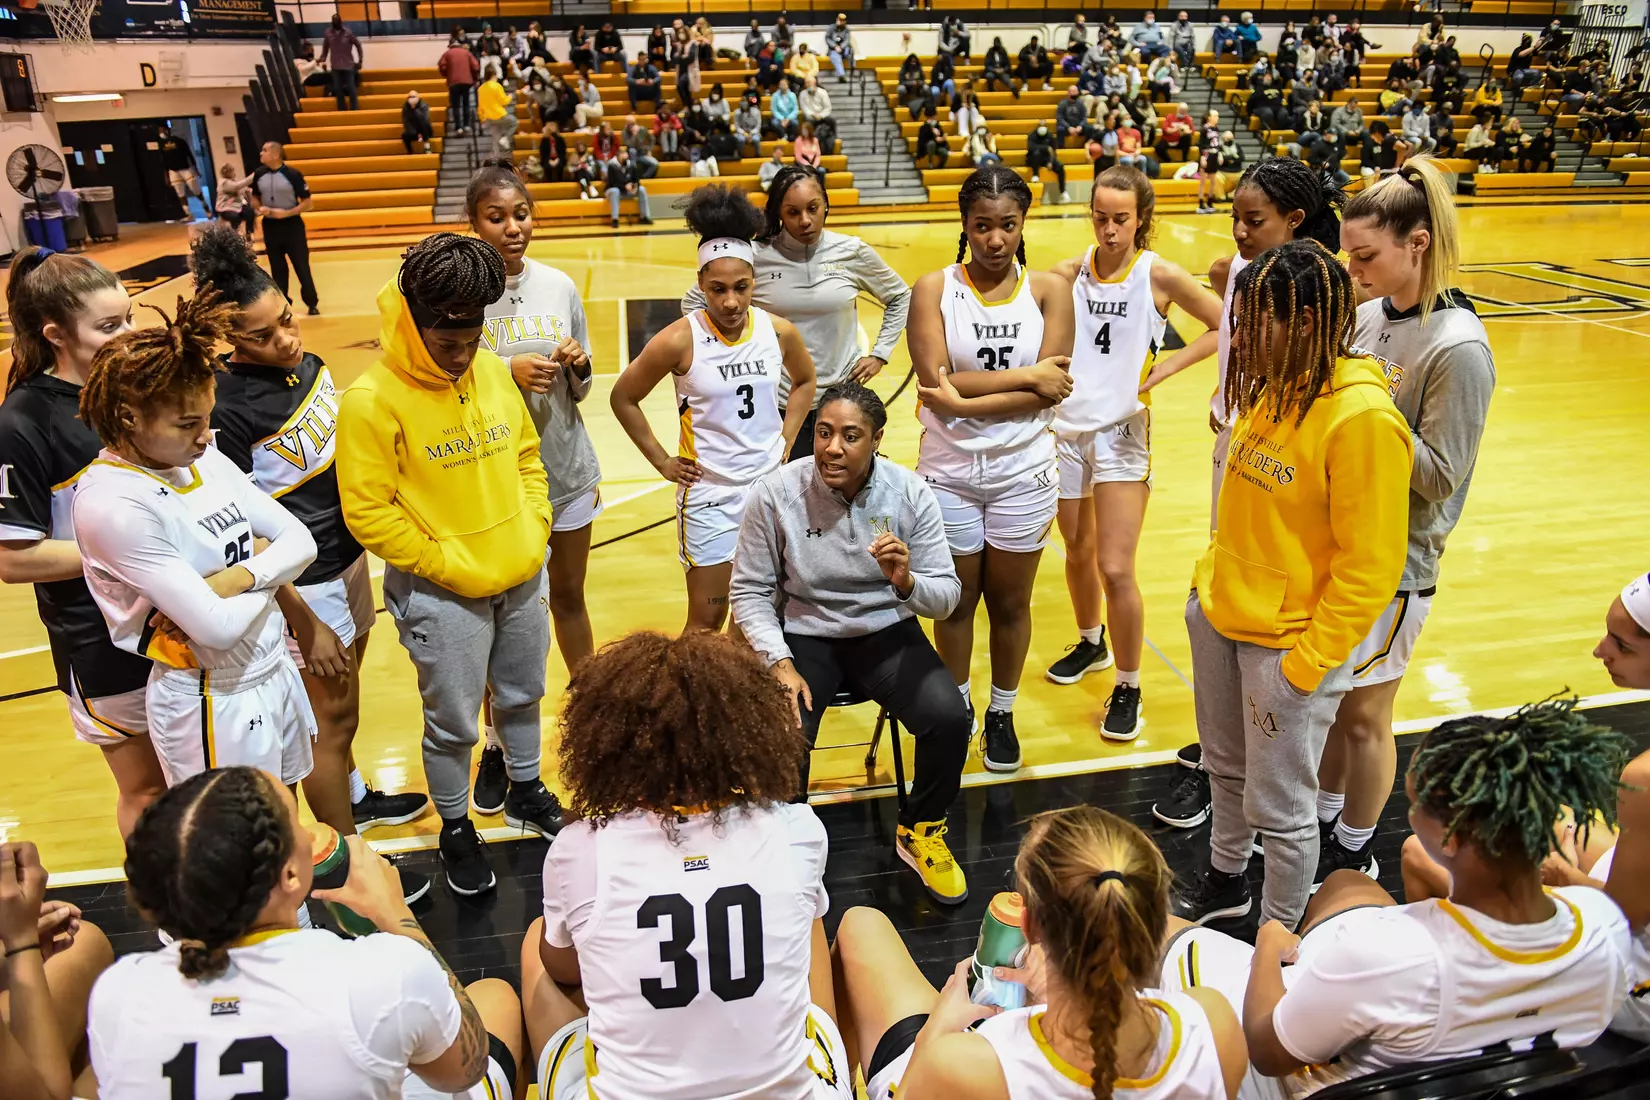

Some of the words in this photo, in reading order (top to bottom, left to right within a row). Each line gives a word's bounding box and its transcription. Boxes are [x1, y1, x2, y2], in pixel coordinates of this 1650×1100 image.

[199, 0, 263, 10] MANAGEMENT
[140, 63, 157, 87] D
[1086, 299, 1128, 318] VILLE
[1094, 322, 1111, 354] 4
[717, 359, 768, 381] VILLE
[736, 384, 755, 420] 3
[197, 501, 248, 539] VILL
[683, 858, 710, 869] PSAC
[636, 882, 765, 1010] 30
[211, 1000, 241, 1012] PSAC
